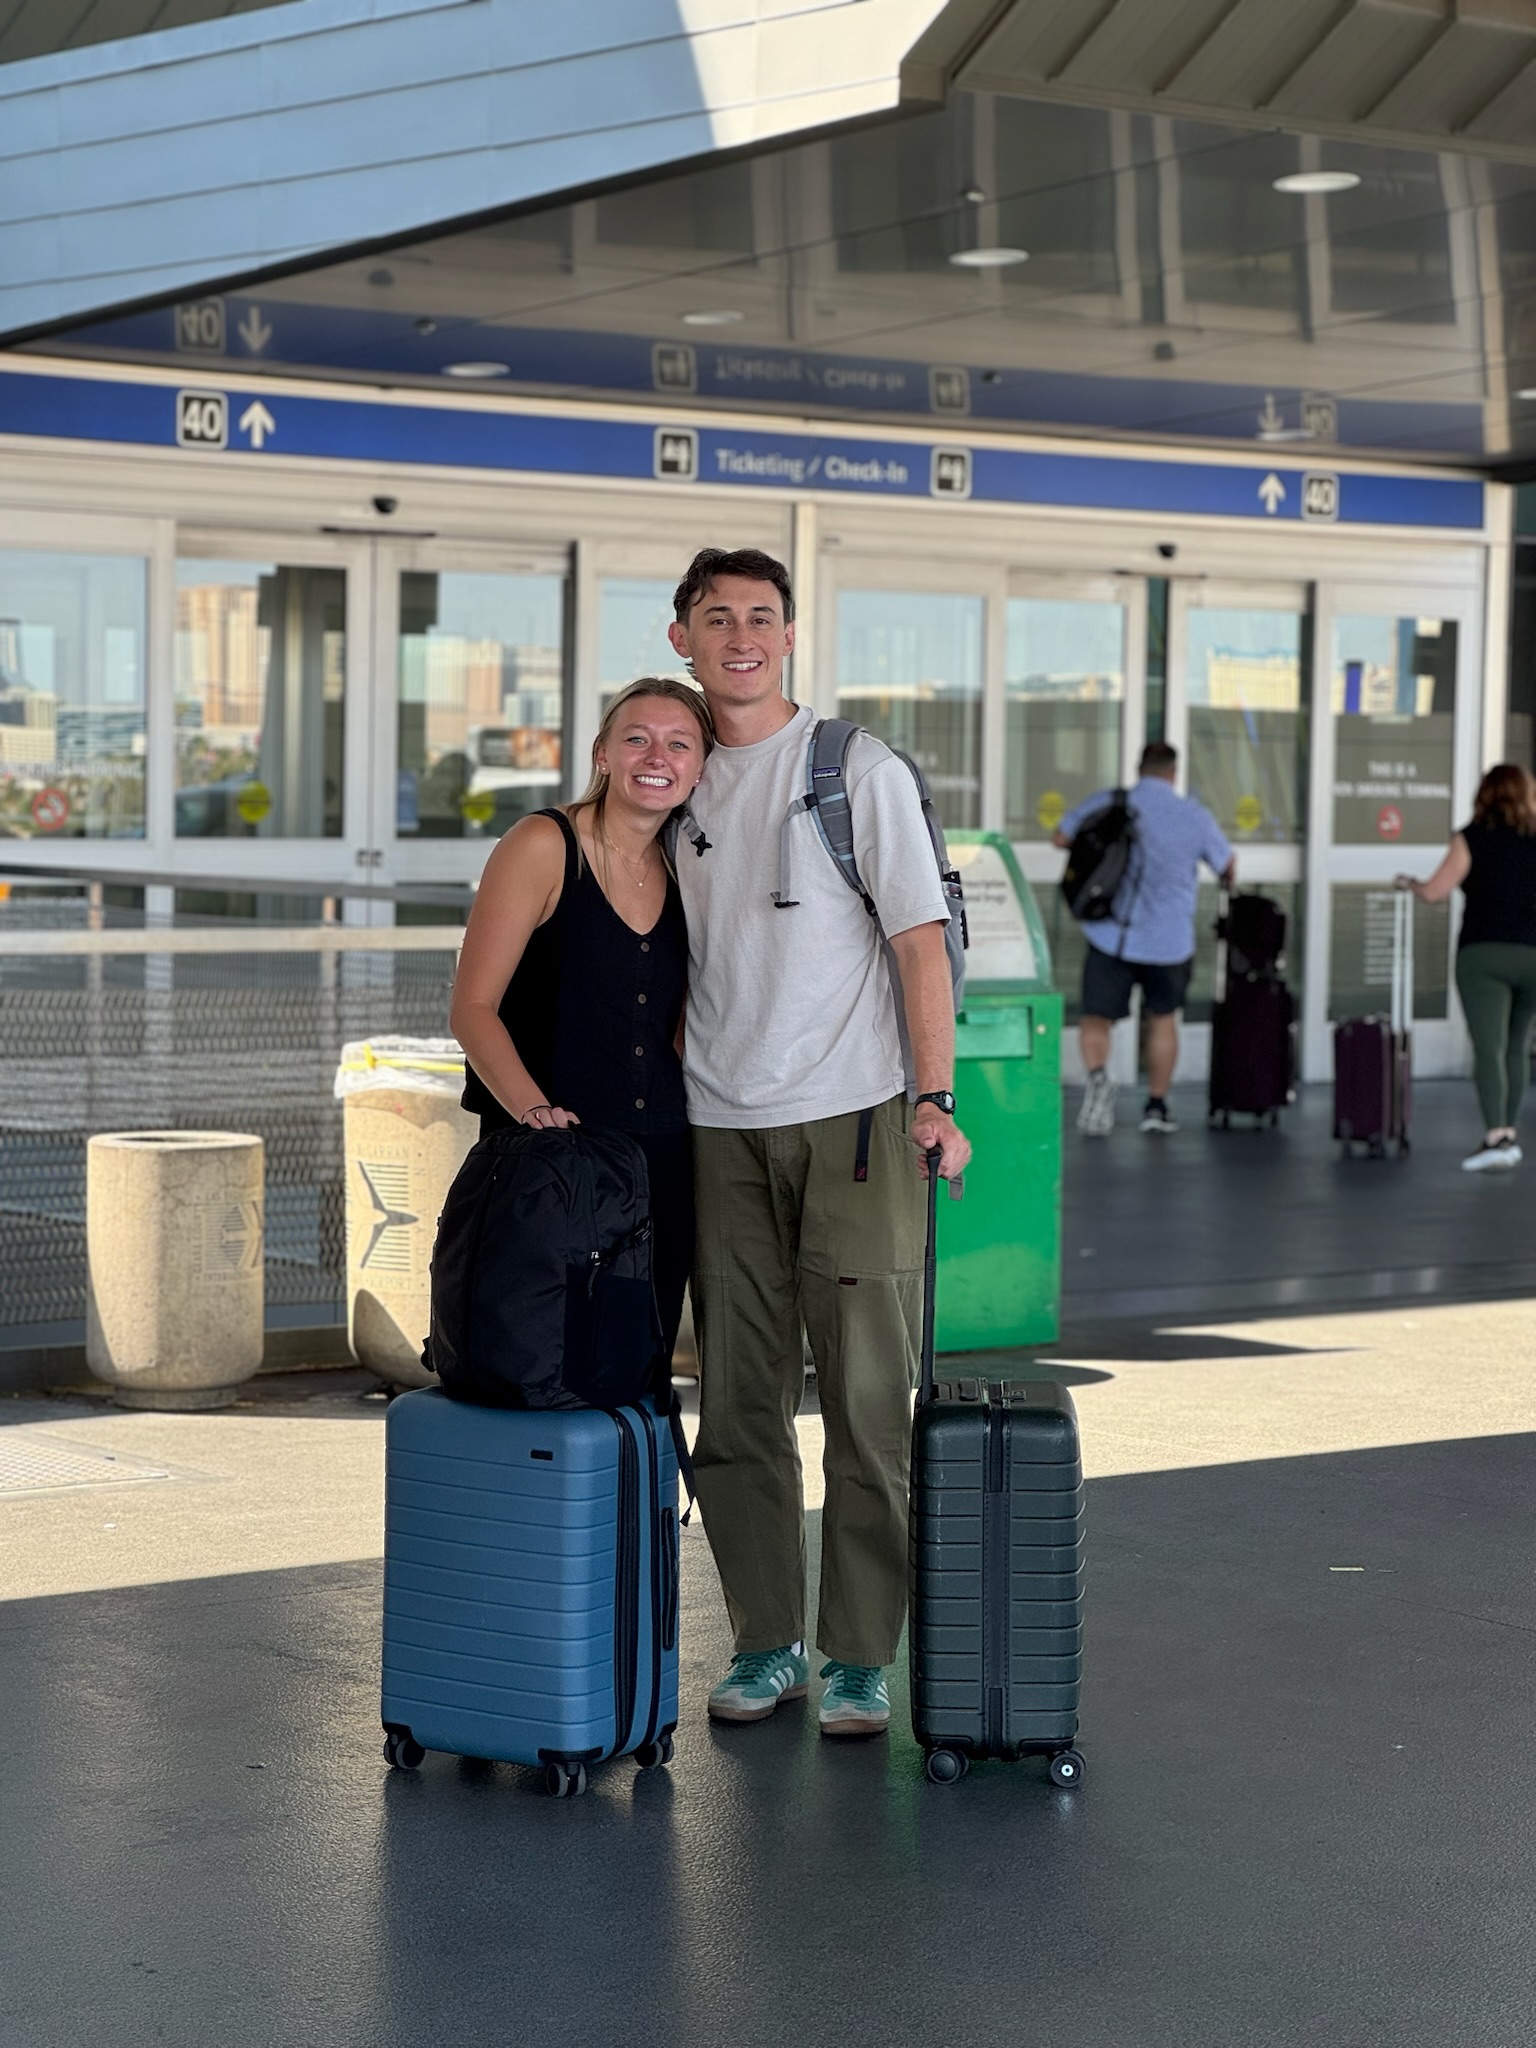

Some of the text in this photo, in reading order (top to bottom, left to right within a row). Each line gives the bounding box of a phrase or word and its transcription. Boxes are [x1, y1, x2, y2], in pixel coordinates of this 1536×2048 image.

[183, 399, 223, 440] 40
[715, 449, 804, 482] Ticketing
[1304, 480, 1335, 514] 40
